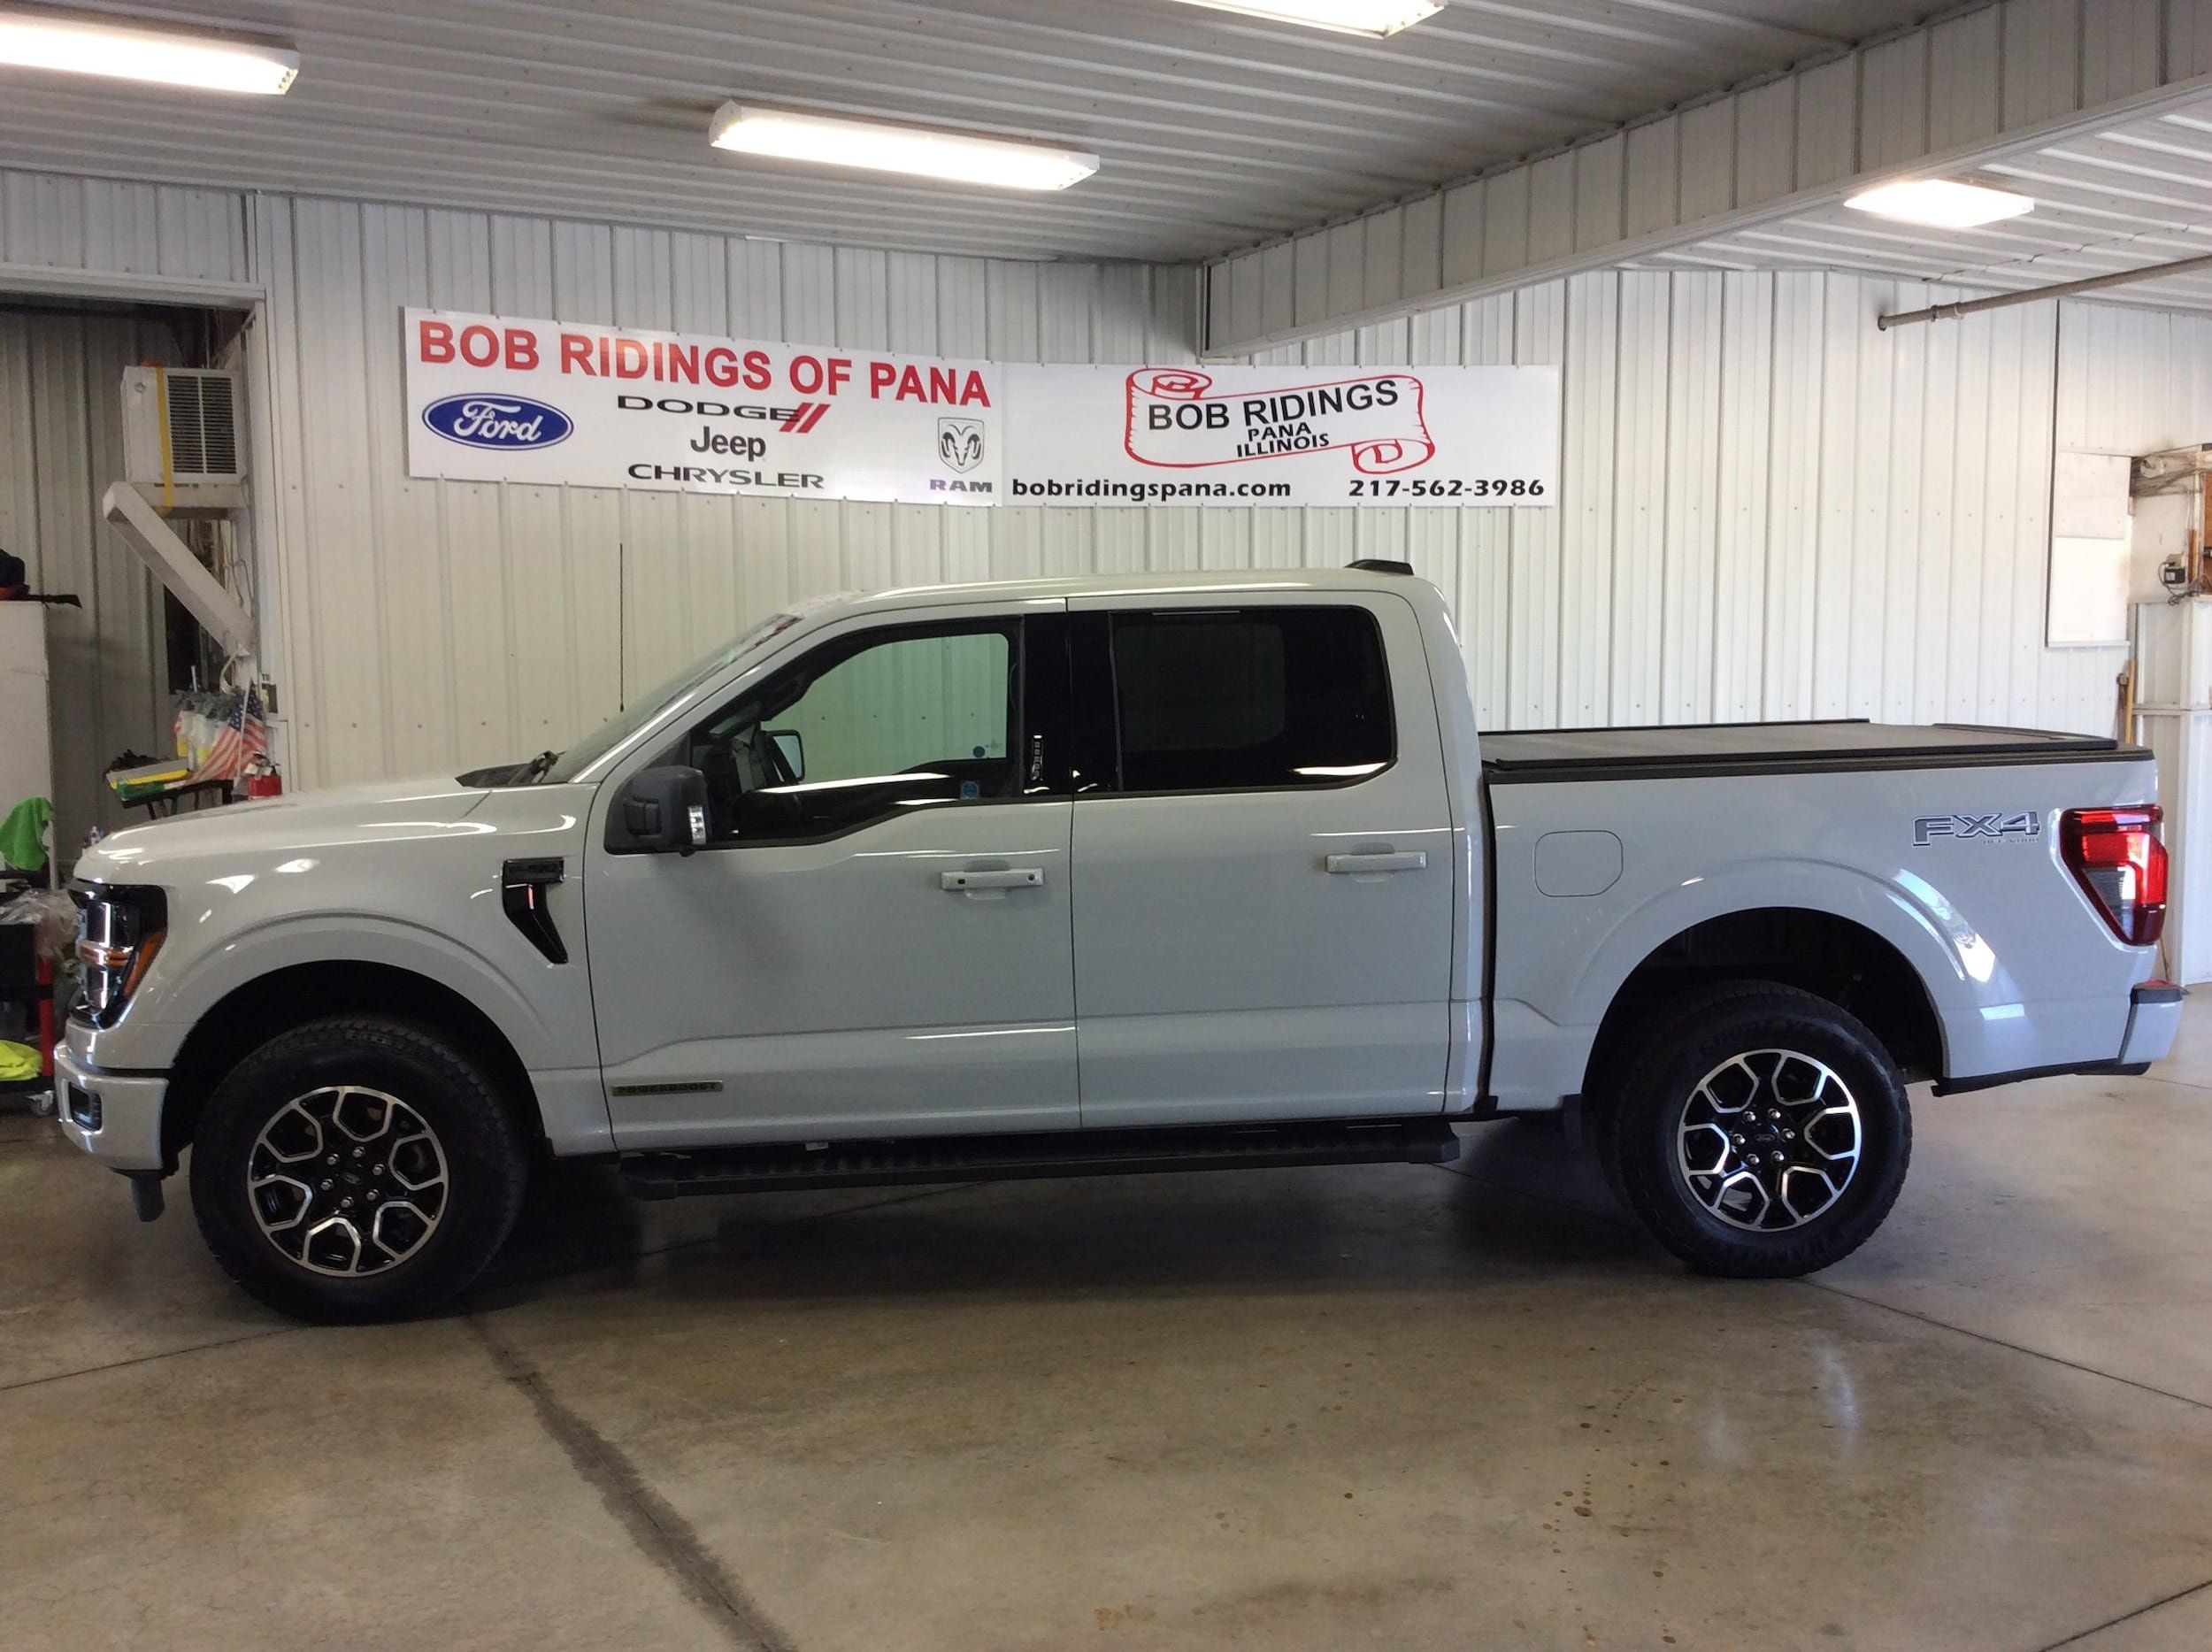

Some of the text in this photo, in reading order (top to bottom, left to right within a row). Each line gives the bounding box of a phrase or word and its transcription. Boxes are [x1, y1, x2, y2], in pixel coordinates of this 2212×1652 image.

[419, 320, 991, 408] BOB RIDINGS OF PANA
[618, 396, 801, 423] DODGE
[1148, 380, 1399, 431] BOB RIDINGS
[453, 401, 542, 442] Ford
[1248, 422, 1312, 442] PANA
[690, 426, 766, 462] Jeep
[1236, 434, 1330, 458] ILLINOIS
[627, 464, 825, 489] CHRYSLER
[929, 479, 993, 493] RAM
[1348, 480, 1545, 496] 217-562-3986
[1012, 479, 1291, 502] bobridingspana.com
[1912, 811, 2040, 847] FX4
